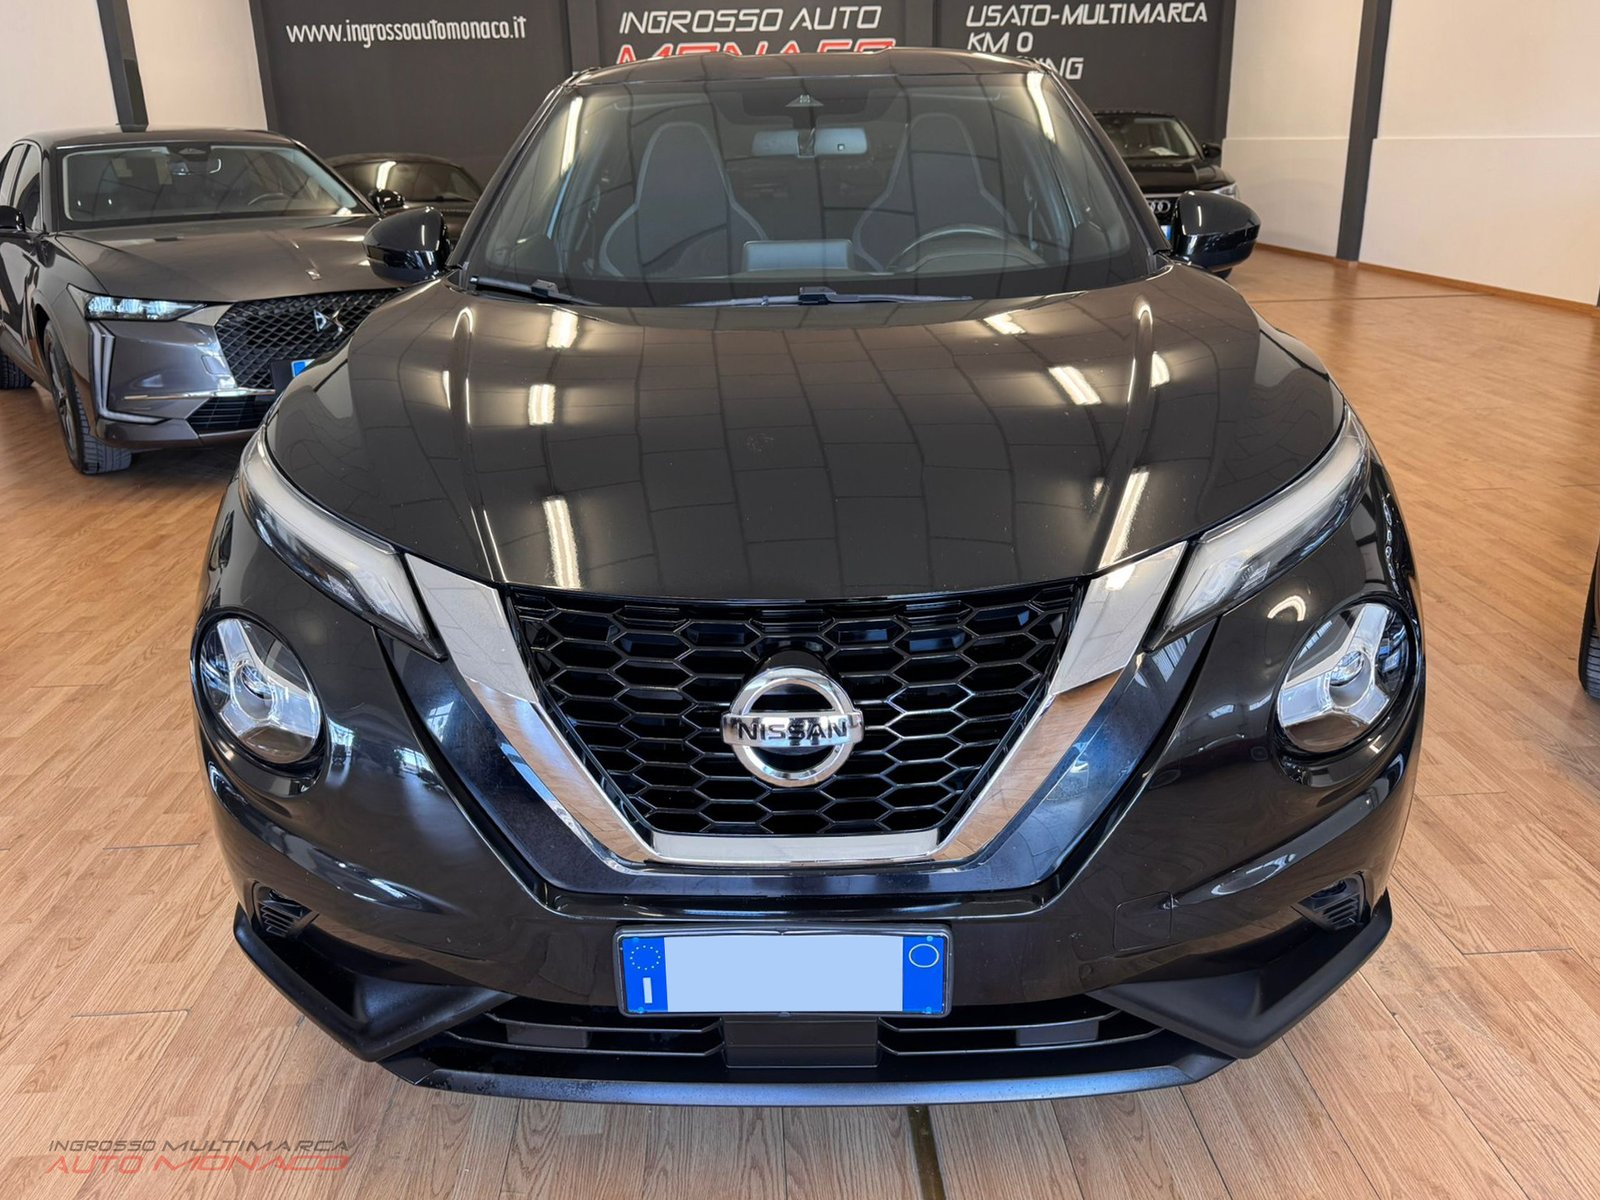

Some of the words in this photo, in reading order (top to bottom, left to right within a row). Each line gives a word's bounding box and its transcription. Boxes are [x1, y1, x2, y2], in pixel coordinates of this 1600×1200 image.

[619, 8, 783, 34] INGROSSO
[789, 6, 882, 30] AUTO
[966, 2, 1208, 27] USATO-MULTIMARCA
[286, 16, 526, 48] www.ingrossoautomonaco.it
[967, 32, 1010, 53] KM
[738, 720, 848, 741] NISSAN
